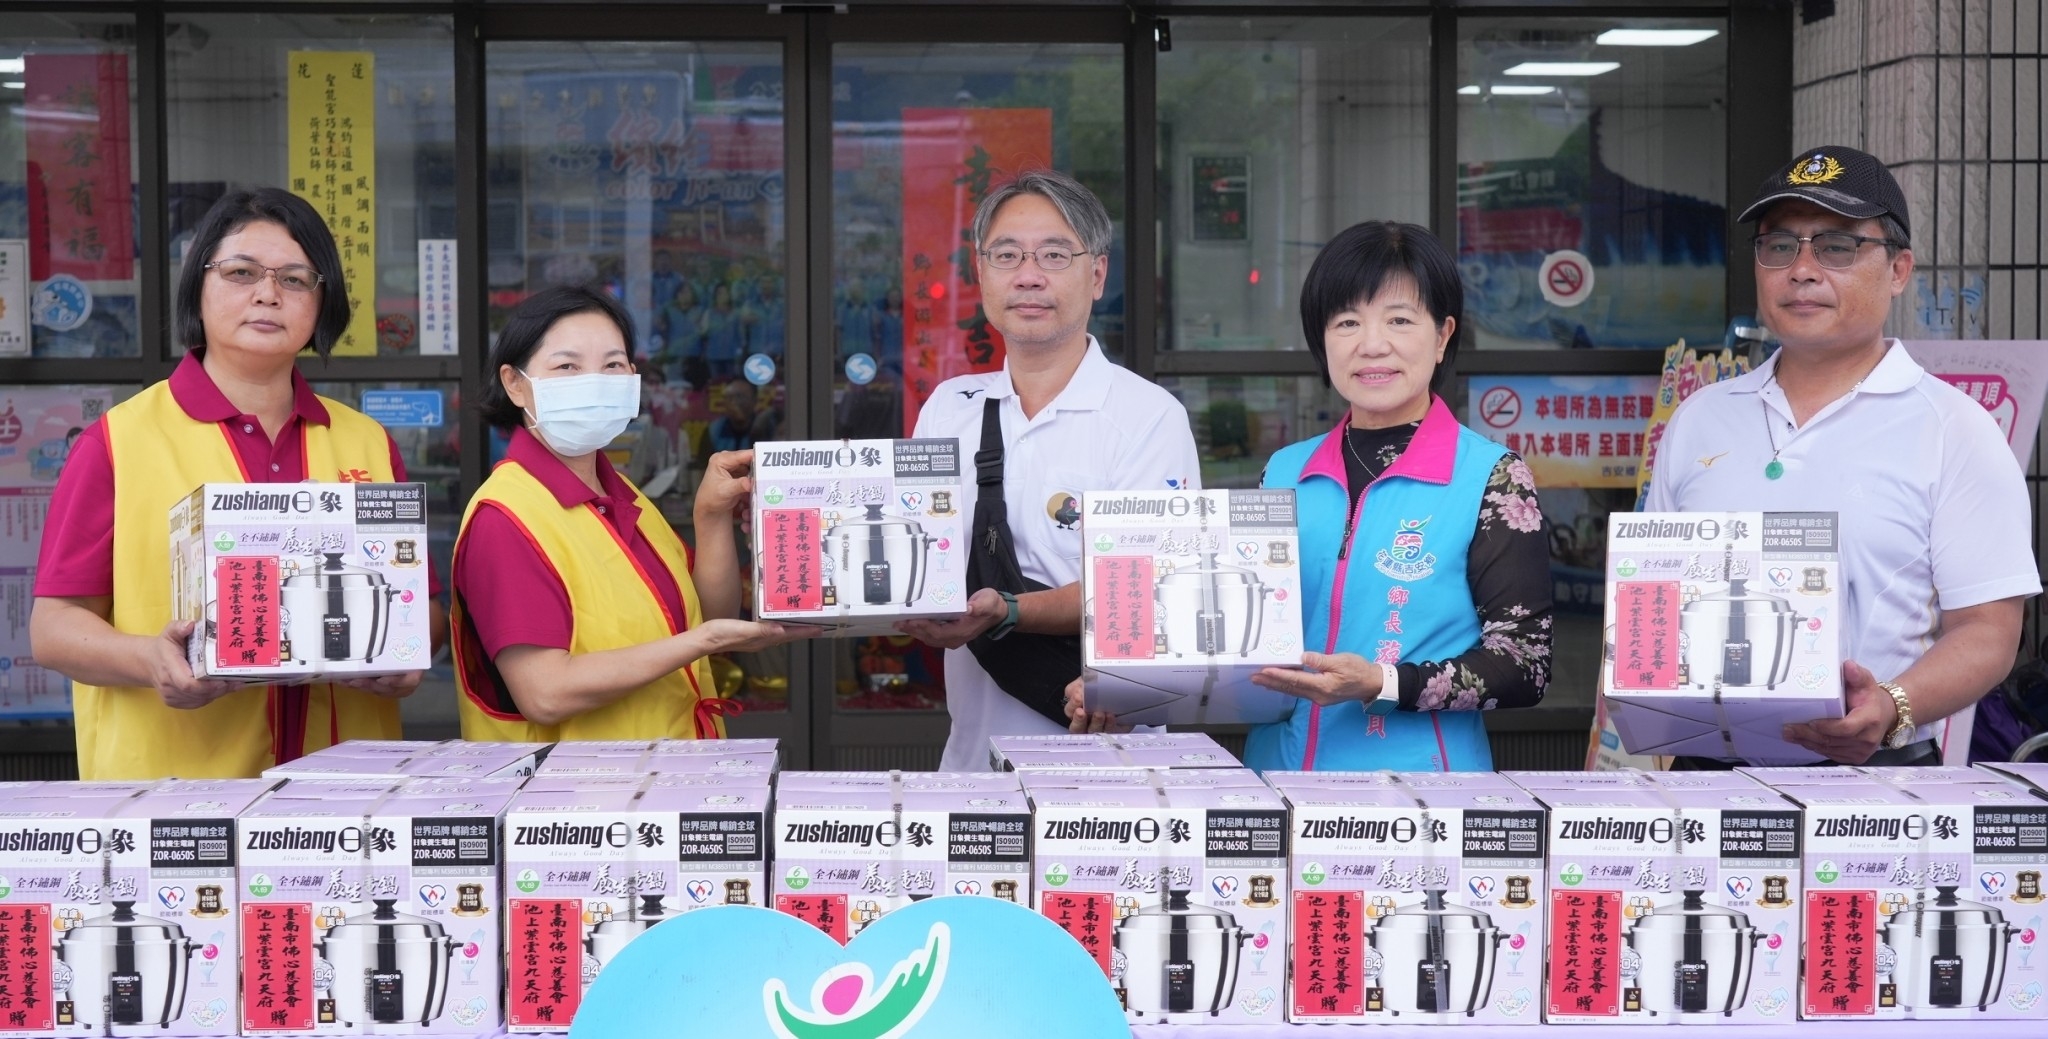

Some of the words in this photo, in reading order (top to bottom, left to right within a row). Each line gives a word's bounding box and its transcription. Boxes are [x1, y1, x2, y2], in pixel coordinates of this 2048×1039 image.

[760, 447, 834, 470] zushiang
[896, 462, 929, 472] ZOR-0650S
[211, 491, 291, 514] zushiang
[358, 509, 393, 519] ZOR-0650S
[1208, 818, 1243, 828] 世界品牌
[1465, 818, 1500, 828] 世界品牌
[1723, 819, 1758, 829] 世界品牌
[1976, 814, 2011, 824] 世界品牌
[414, 825, 450, 836] 世界品牌
[682, 821, 718, 832] 世界品牌
[951, 822, 987, 832] 世界品牌
[1043, 817, 1132, 843] zushiang
[1301, 817, 1389, 842] zushiang
[1560, 818, 1648, 843] zushiang
[1814, 814, 1901, 841] zushiang
[153, 827, 189, 838] 世界品牌
[514, 822, 605, 849] zushiang
[784, 821, 874, 846] zushiang
[1253, 833, 1279, 841] ISO9001
[1510, 833, 1536, 841] ISO9001
[1768, 834, 1794, 842] ISO9001
[2020, 828, 2046, 837] ISO9001
[0, 828, 75, 856] ushiang
[246, 827, 337, 854] zushiang
[460, 840, 487, 849] ISO9001
[728, 835, 754, 844] ISO9001
[996, 837, 1023, 845] ISO9001
[1976, 836, 2016, 847] ZOR-0650S
[199, 841, 226, 850] ISO9001
[682, 843, 724, 855] ZOR-0650S
[951, 844, 992, 855] ZOR-0650S
[1208, 840, 1249, 851] ZOR-0650S
[1465, 840, 1505, 851] ZOR-0650S
[1723, 841, 1763, 851] ZOR-0650S
[153, 850, 195, 861] ZOR-0650S
[414, 848, 456, 859] ZOR-0650S
